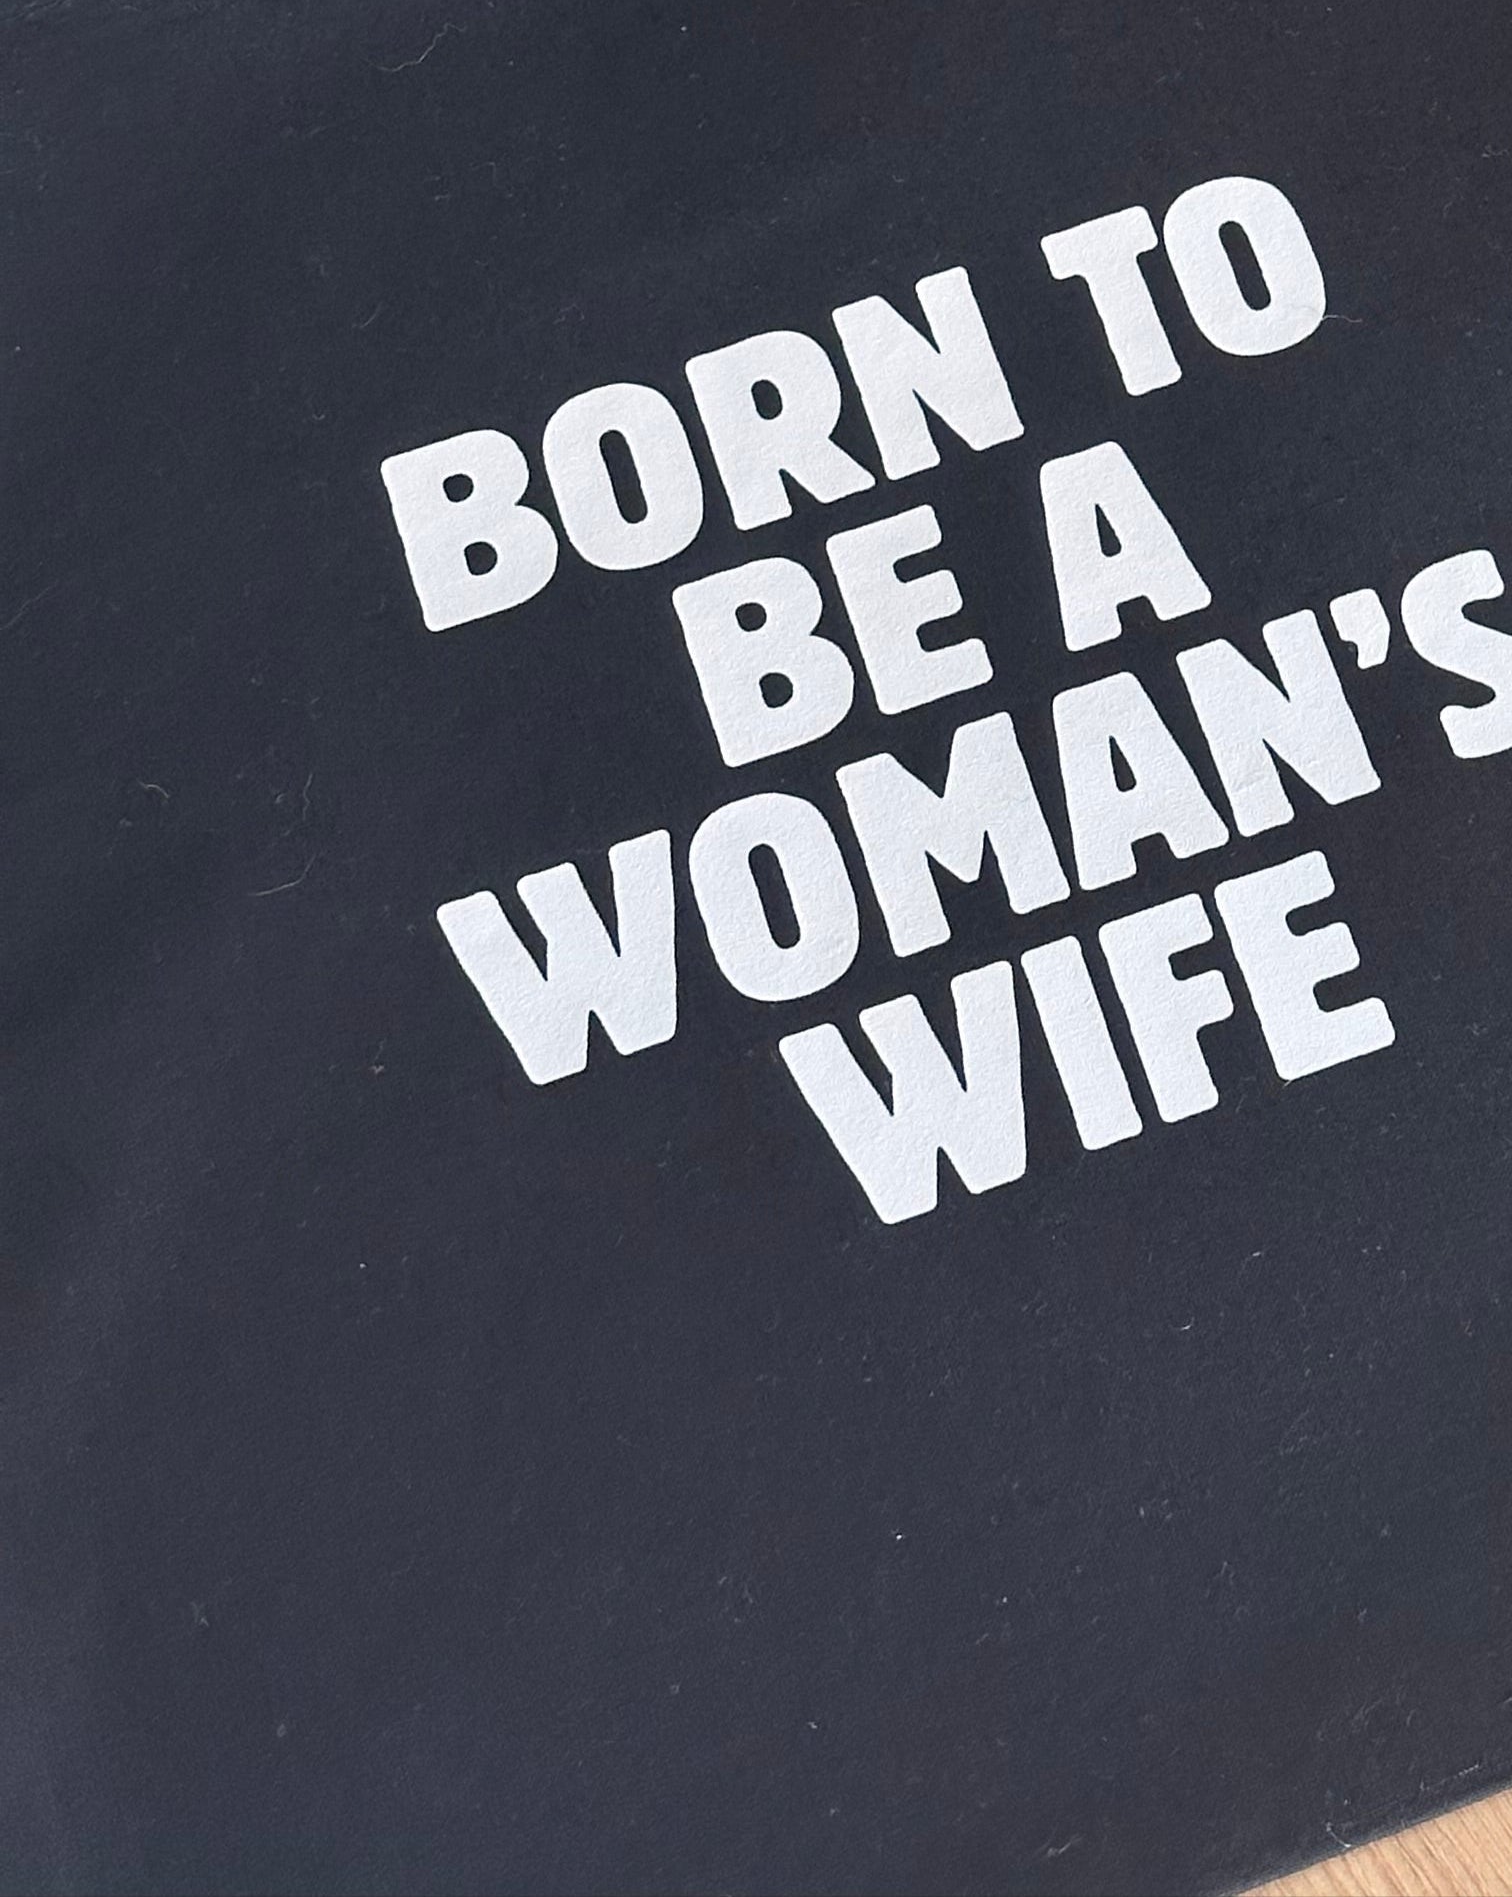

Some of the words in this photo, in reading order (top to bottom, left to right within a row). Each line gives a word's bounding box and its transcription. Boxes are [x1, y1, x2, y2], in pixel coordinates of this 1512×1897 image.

[380, 265, 1025, 632] BORN
[1040, 176, 1327, 397] TO
[671, 504, 994, 768] BE
[1039, 441, 1212, 652] A
[778, 850, 1396, 1225] WIFE
